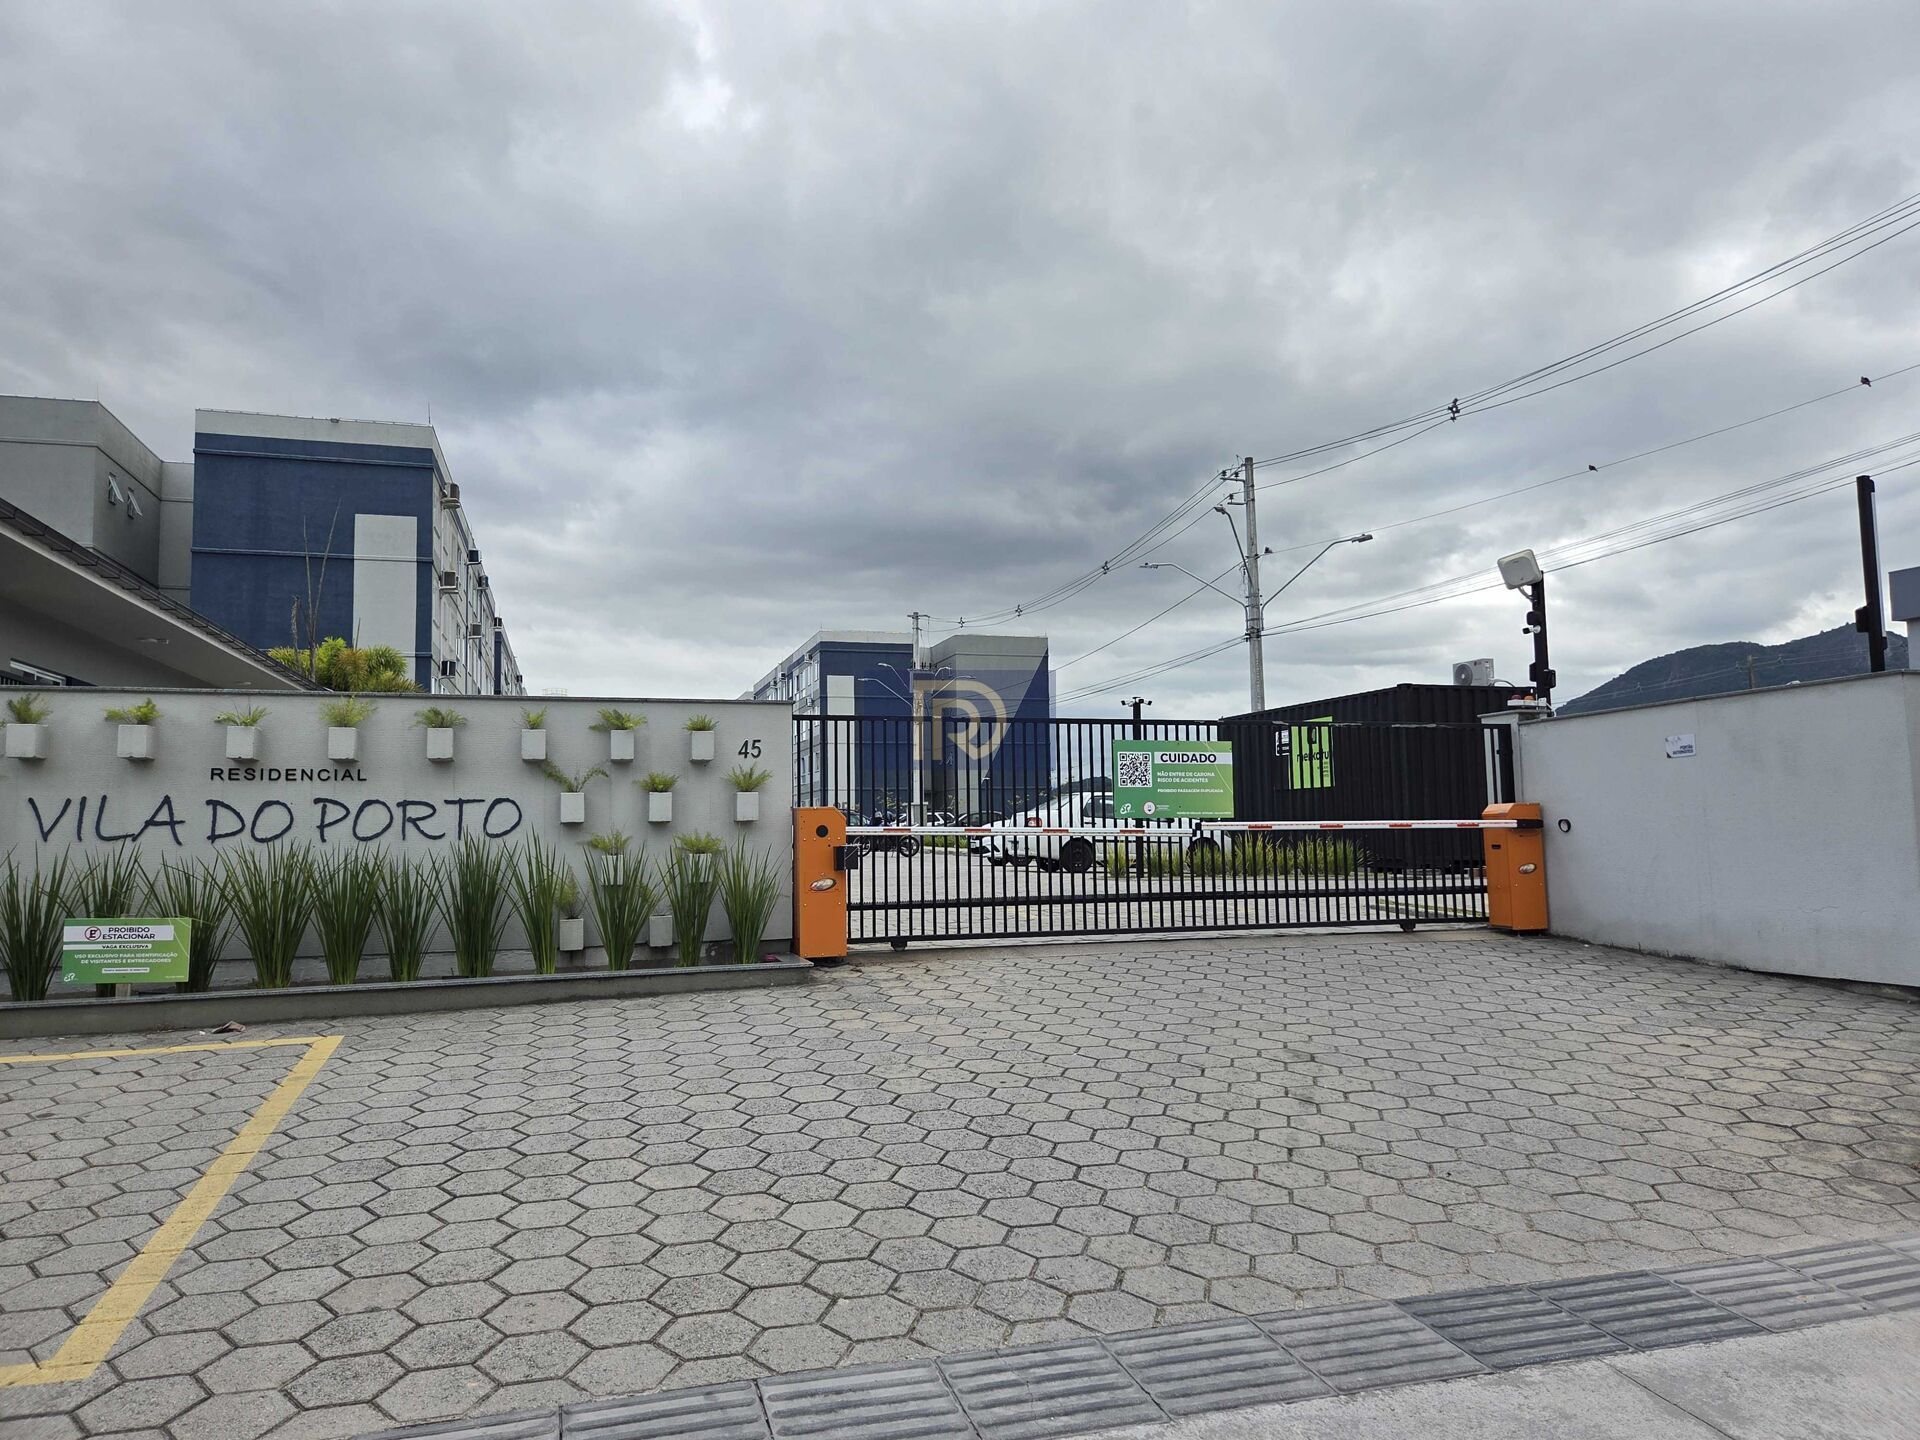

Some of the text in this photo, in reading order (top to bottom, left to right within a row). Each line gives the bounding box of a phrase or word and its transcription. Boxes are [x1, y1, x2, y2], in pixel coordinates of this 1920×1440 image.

[738, 739, 762, 759] 45
[1160, 753, 1217, 763] CUIDADO
[210, 767, 368, 781] RESIDENCIAL
[28, 794, 523, 846] VILA DO PORTO
